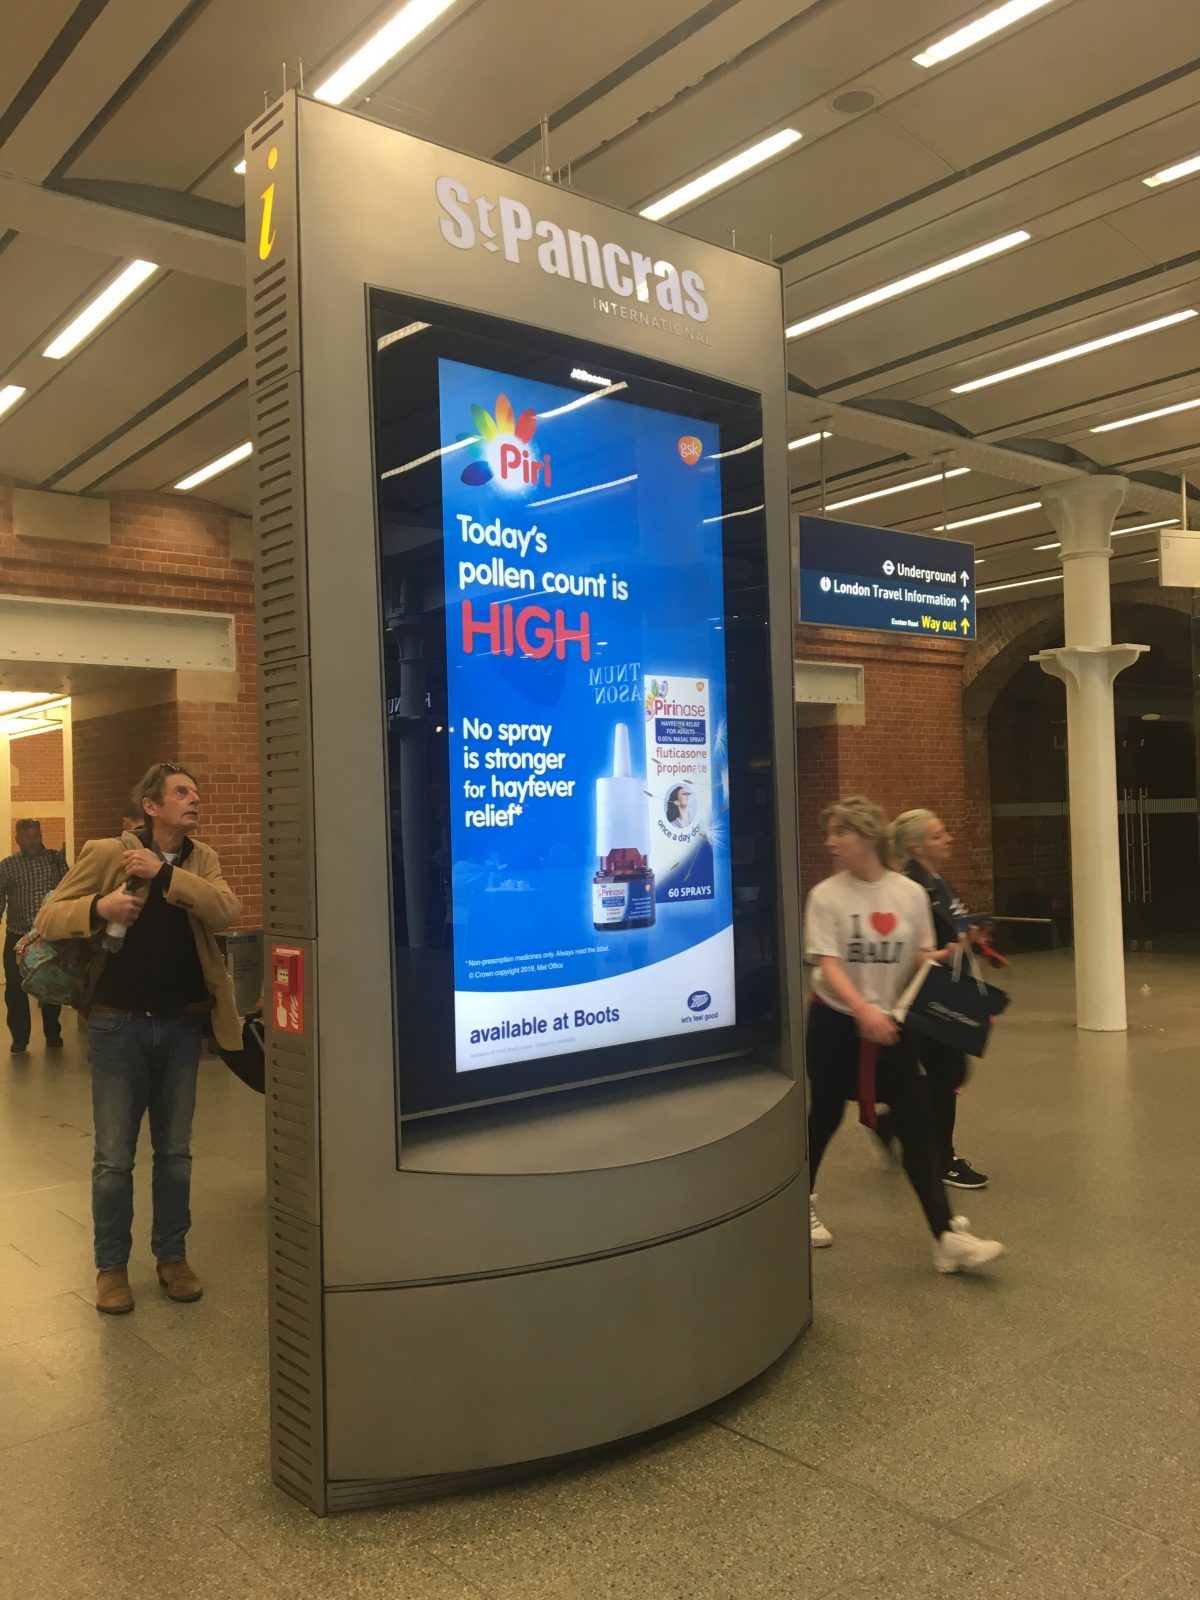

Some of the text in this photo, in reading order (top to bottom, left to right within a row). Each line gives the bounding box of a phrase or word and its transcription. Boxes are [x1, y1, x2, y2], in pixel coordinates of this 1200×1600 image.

[498, 195, 709, 323] Pancras
[592, 297, 712, 346] INTERNATIONAL
[680, 441, 699, 457] gsk
[500, 443, 552, 487] Piri
[456, 513, 548, 557] Today's
[459, 557, 628, 600] pollen count is
[897, 563, 956, 583] Underground
[834, 579, 956, 607] London Travel Information
[462, 599, 591, 662] HIGH
[921, 615, 957, 632] Way out
[654, 699, 706, 717] Pirinase
[463, 717, 552, 747] No spray
[464, 745, 566, 775] is stronger
[656, 746, 707, 759] fluticasone
[464, 774, 576, 804] for hayfever
[657, 819, 672, 839] once
[678, 832, 690, 844] day
[668, 885, 712, 898] 60 SPRAYS
[556, 949, 574, 957] Always
[475, 971, 494, 979] Crown
[494, 967, 520, 977] copyright
[537, 963, 547, 971] Met
[548, 962, 564, 970] Office
[470, 1016, 548, 1044] available
[552, 1012, 569, 1031] at
[574, 1006, 620, 1028] Boots
[704, 1012, 719, 1022] good
